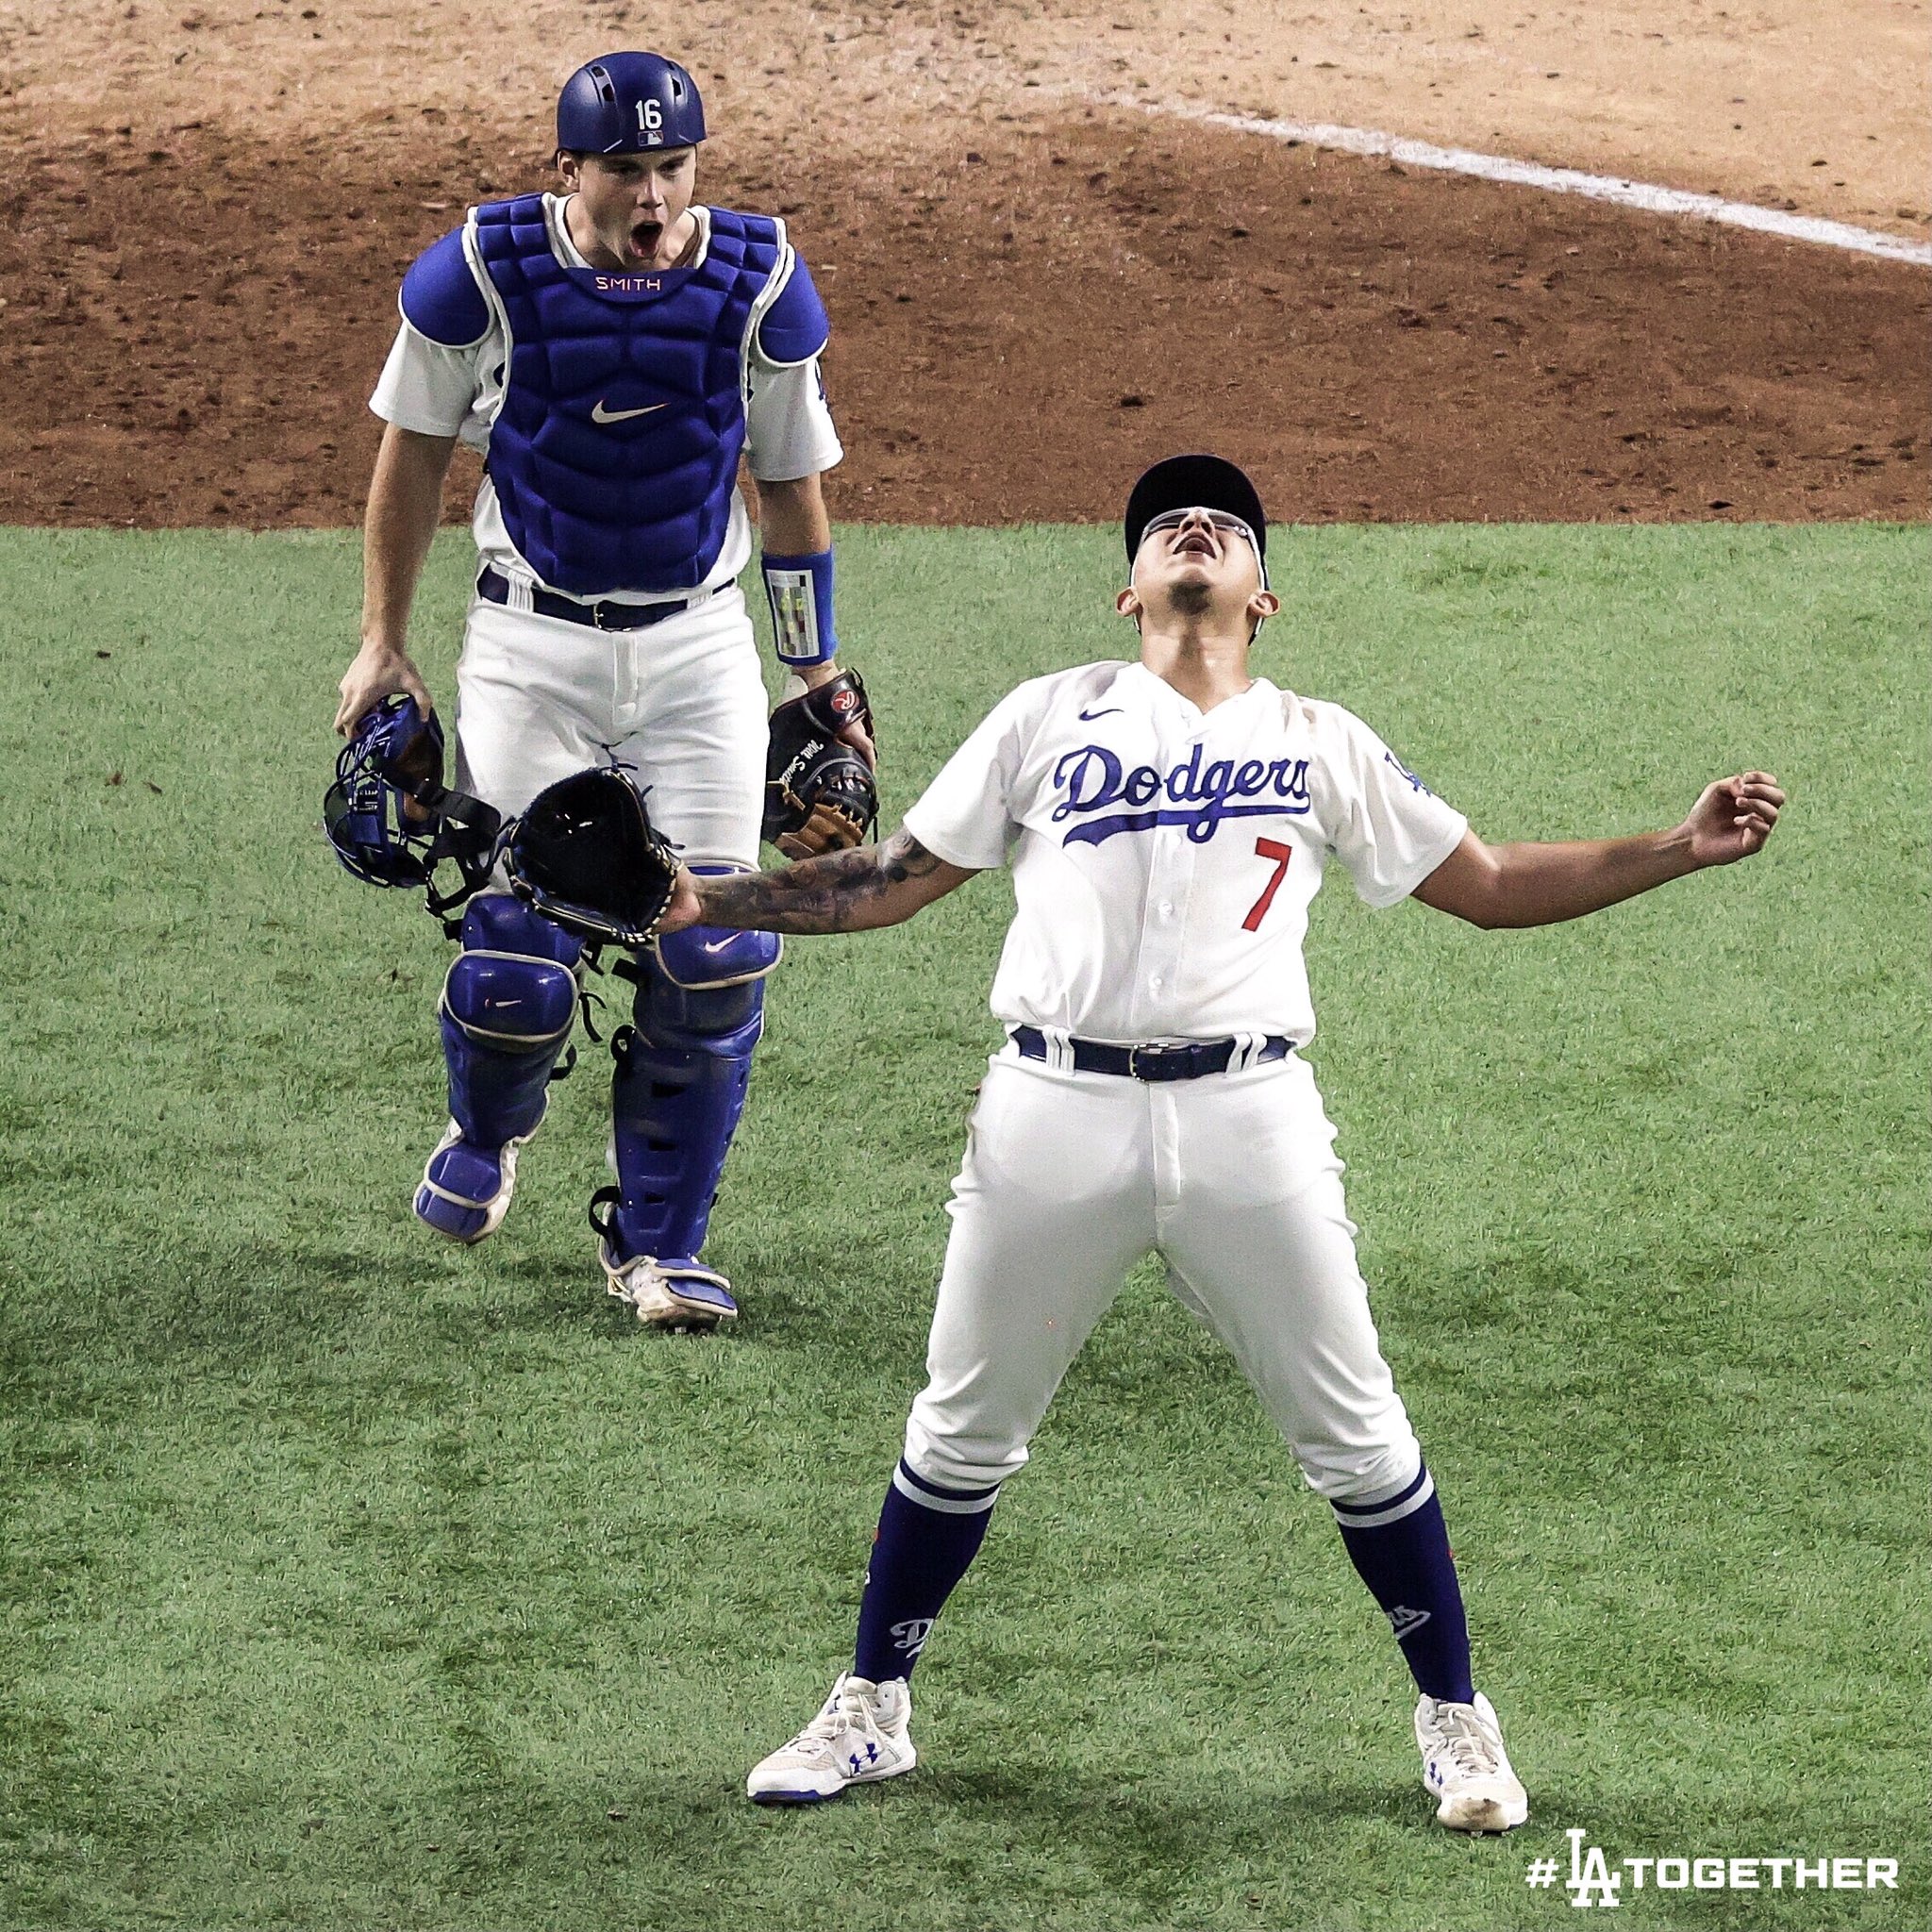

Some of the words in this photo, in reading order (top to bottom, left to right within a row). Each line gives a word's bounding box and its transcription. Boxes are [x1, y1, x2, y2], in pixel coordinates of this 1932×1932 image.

[635, 98, 663, 130] 16
[594, 275, 661, 291] SMITH
[800, 740, 824, 759] Will
[1051, 743, 1311, 849] Dodgers
[1241, 836, 1292, 933] 7
